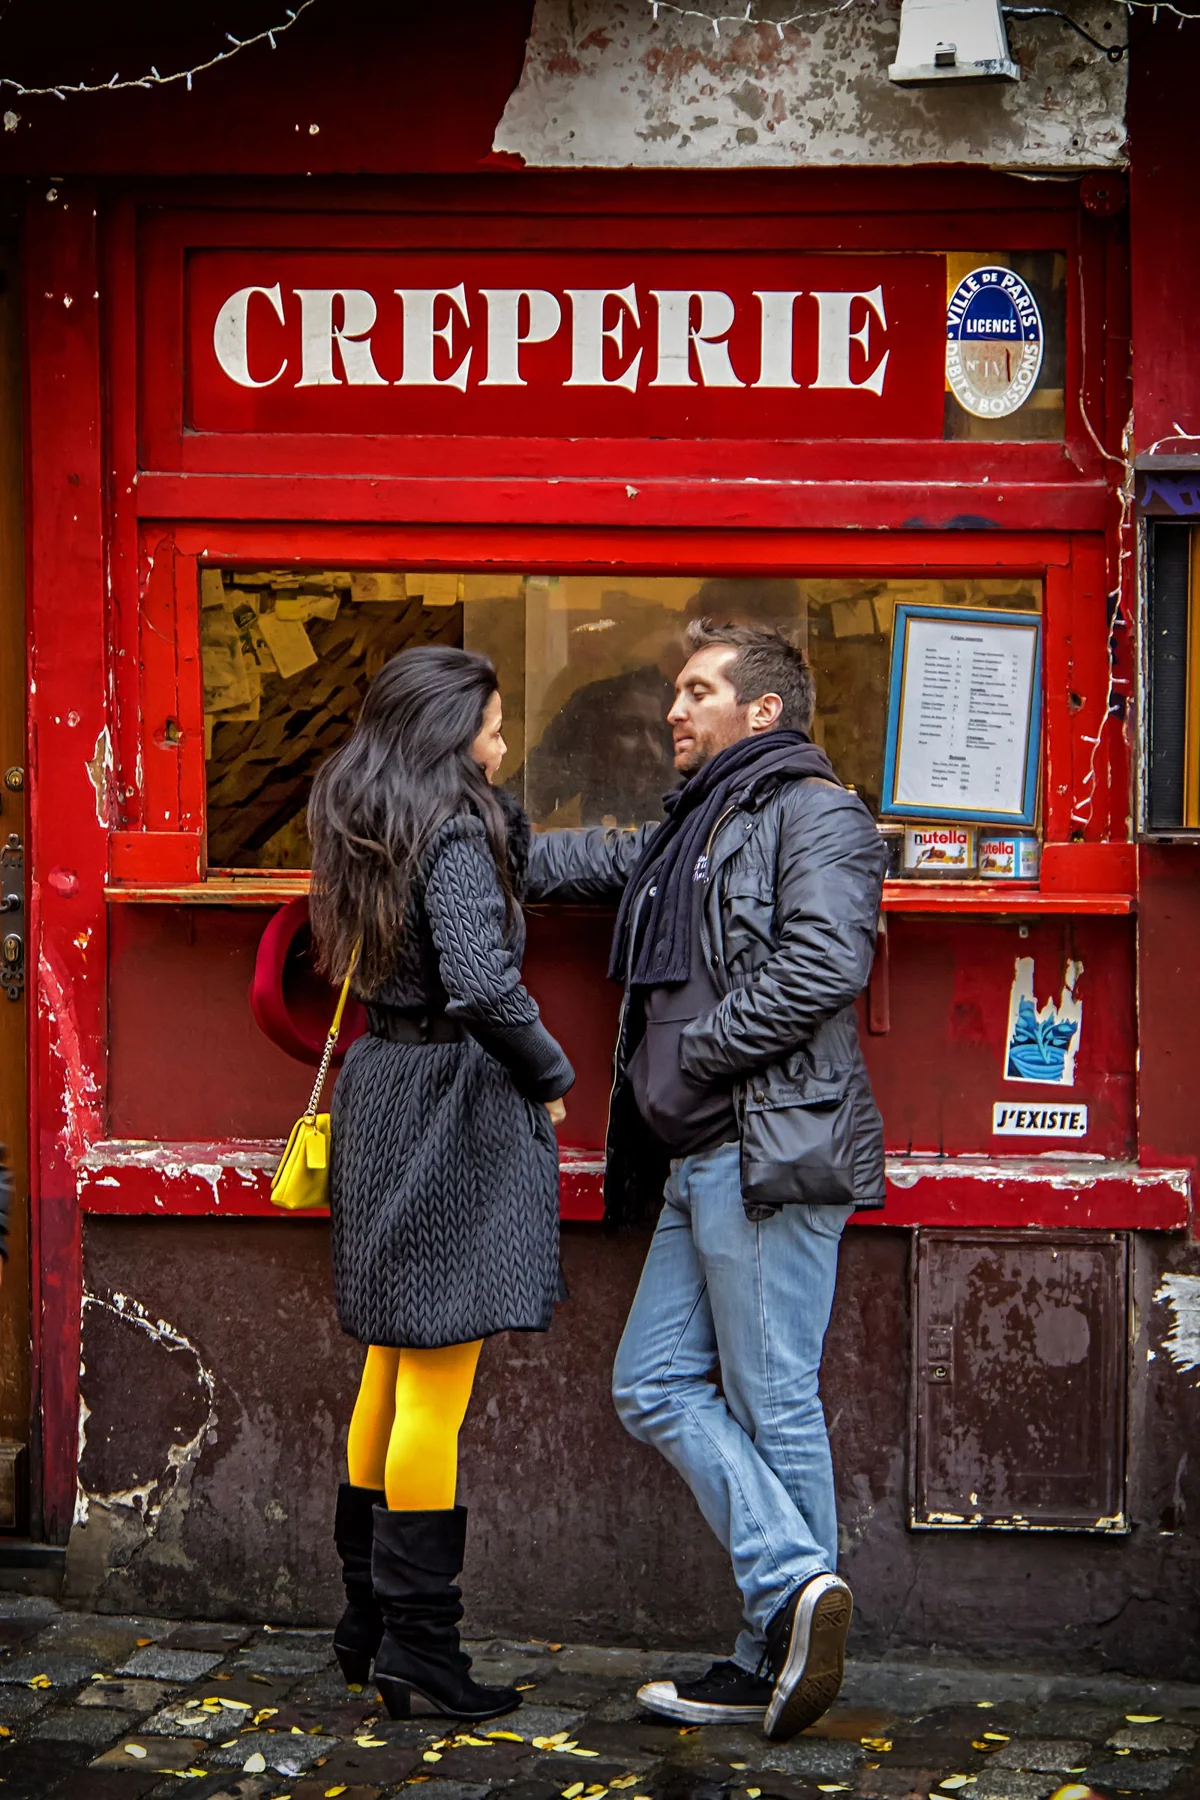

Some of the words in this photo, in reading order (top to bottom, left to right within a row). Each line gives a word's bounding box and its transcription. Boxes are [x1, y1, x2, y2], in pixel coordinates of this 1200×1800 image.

[947, 276, 981, 326] VILLE
[982, 272, 998, 283] DE
[1001, 274, 1037, 327] PARIS
[966, 319, 1017, 334] LICENCE
[213, 282, 890, 397] CREPERIE
[947, 343, 969, 390] DEBIT
[964, 391, 976, 406] DE
[977, 343, 1039, 413] BOISSONS
[914, 830, 967, 844] nutella
[981, 841, 1014, 855] utella
[997, 1110, 1085, 1130] J'EXISTE.
